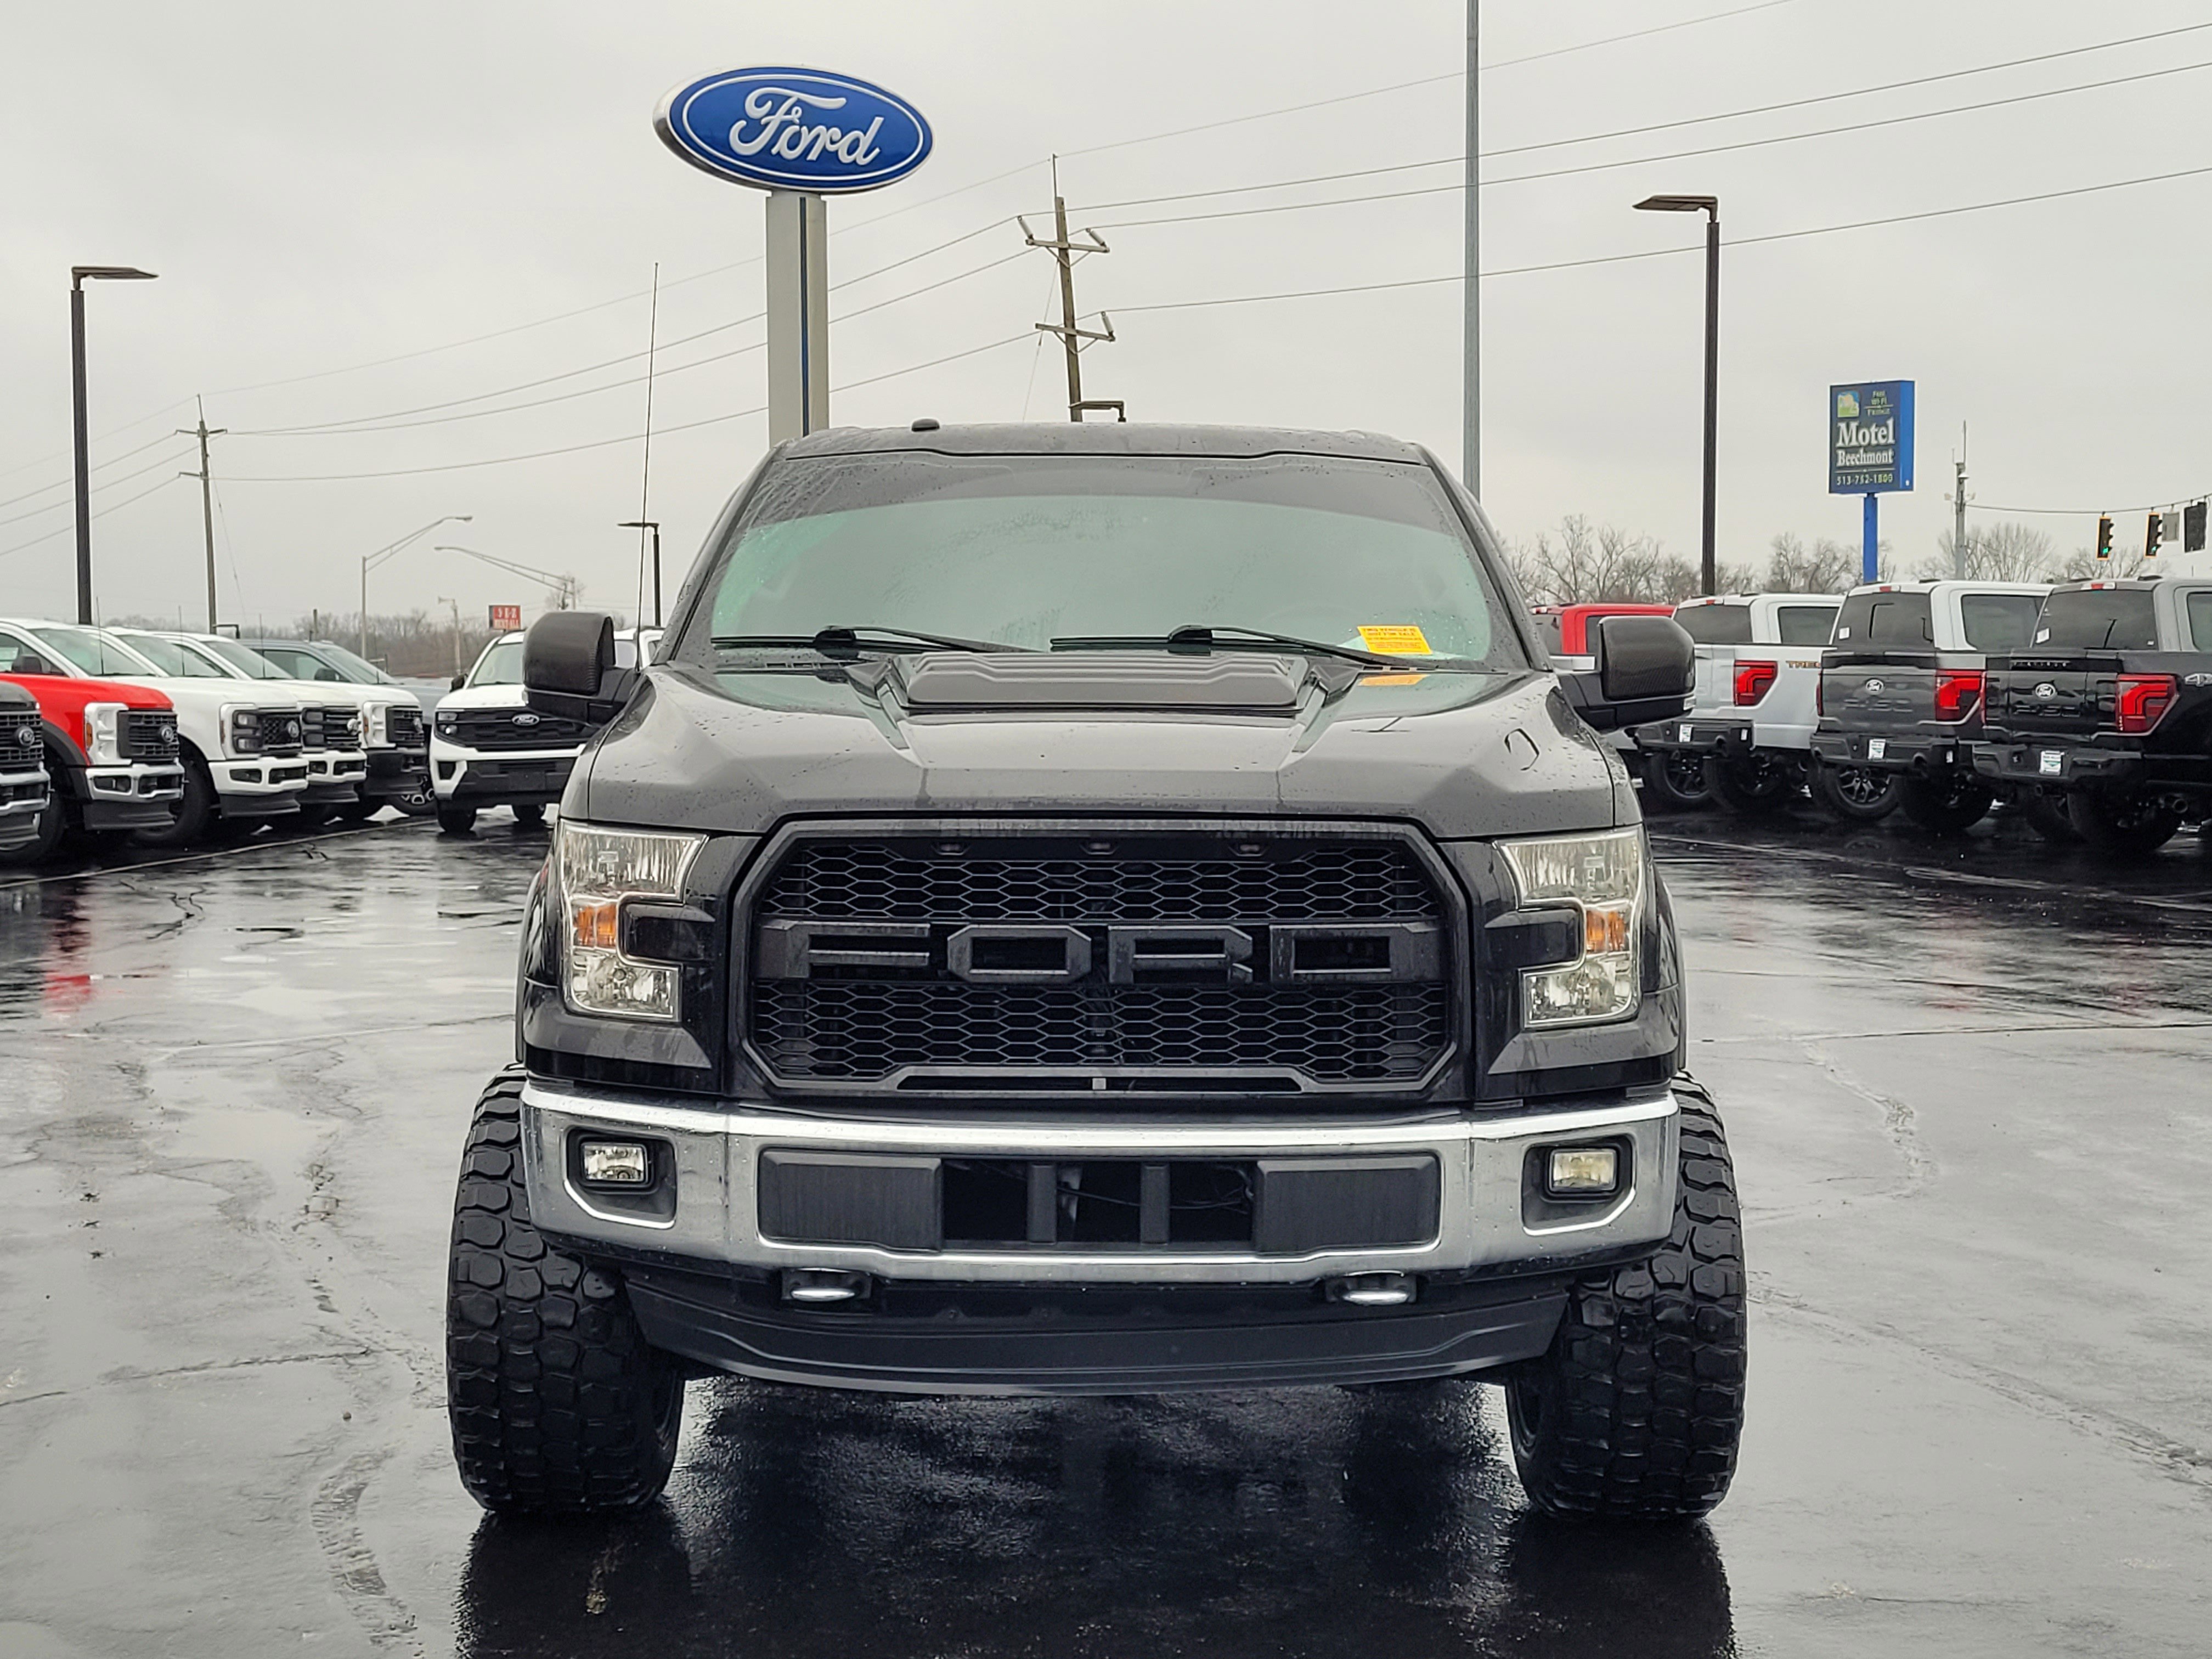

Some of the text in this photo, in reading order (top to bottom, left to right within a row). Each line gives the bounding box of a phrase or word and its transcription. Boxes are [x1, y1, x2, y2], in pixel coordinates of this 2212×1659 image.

[729, 87, 885, 166] Ford
[1836, 417, 1895, 448] Motel
[1836, 448, 1894, 467] Beechmont
[782, 919, 1418, 985] FORD
